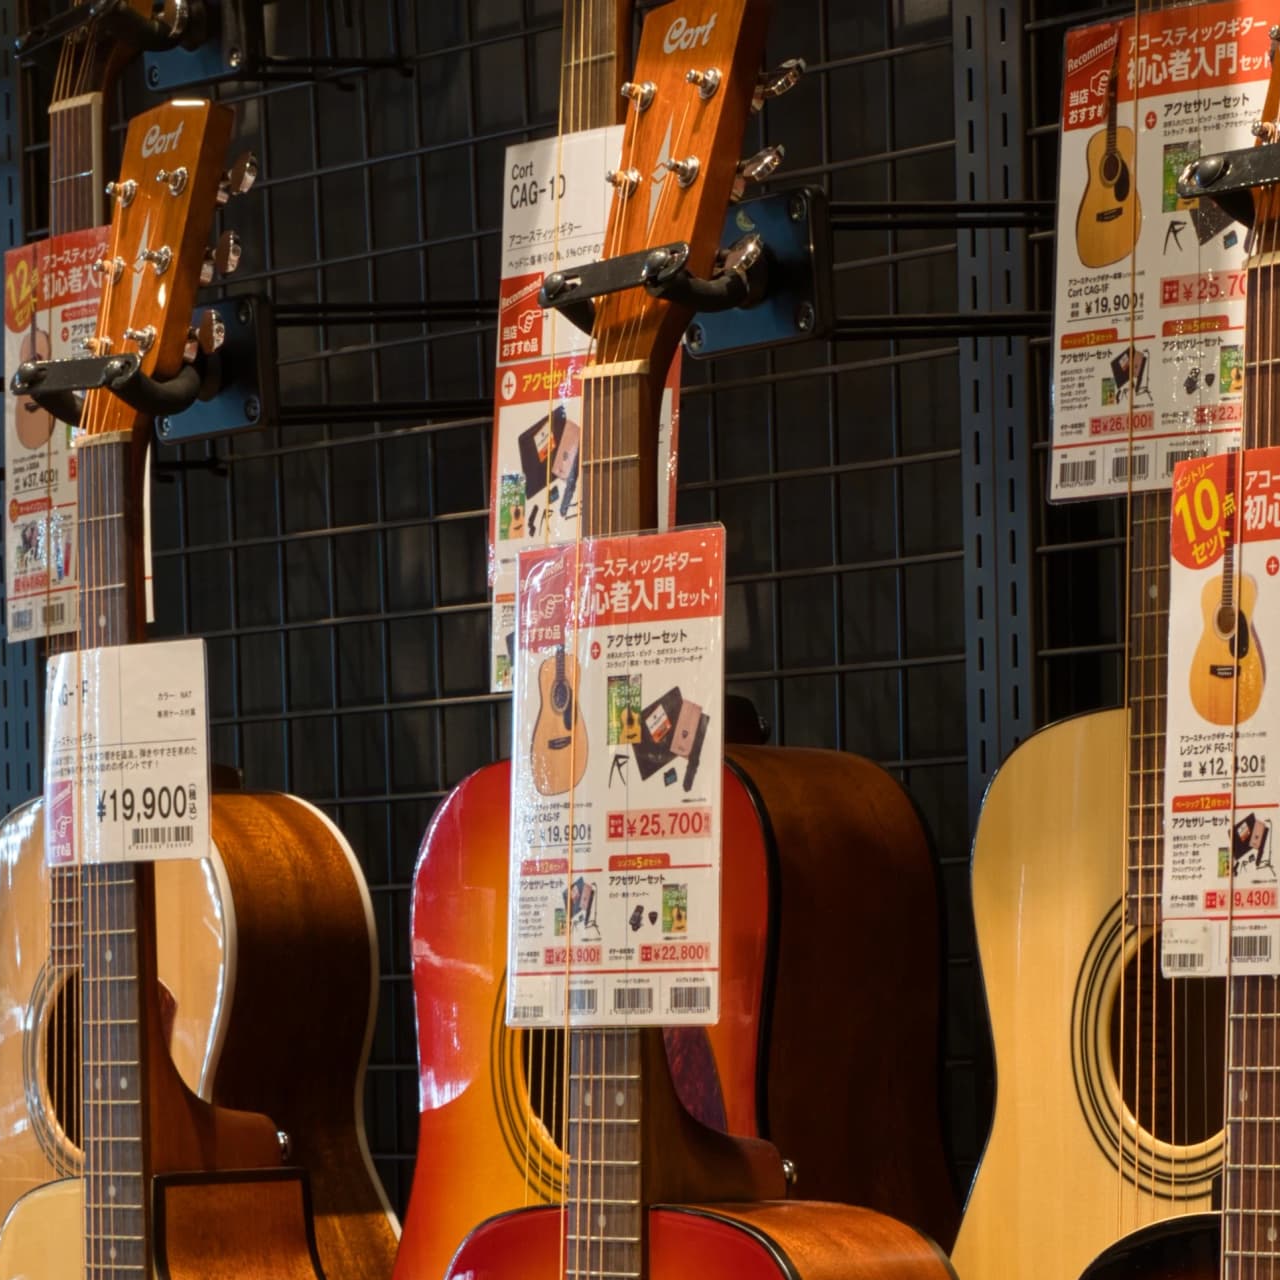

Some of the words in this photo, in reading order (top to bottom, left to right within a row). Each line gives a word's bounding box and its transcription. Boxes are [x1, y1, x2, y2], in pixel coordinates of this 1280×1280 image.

[663, 11, 718, 54] Cort
[1128, 17, 1268, 54] アコースティックギター
[1070, 88, 1089, 107] 当店
[1163, 93, 1250, 117] アクセサリーセット
[142, 121, 184, 158] Cort
[511, 161, 533, 181] Cort
[1060, 348, 1112, 364] アクセサリーセット
[1102, 413, 1148, 431] ¥26,00
[1176, 461, 1215, 491] エントリー
[1191, 525, 1231, 565] セット
[607, 629, 688, 649] アクセサリーセット
[1180, 743, 1212, 756] レジェンド
[97, 785, 188, 822] ¥19,900
[626, 811, 704, 837] ¥25,700
[1172, 816, 1230, 829] アクセサリーセット
[608, 873, 665, 886] アクセサリーセット
[1219, 889, 1270, 908] ¥9,430
